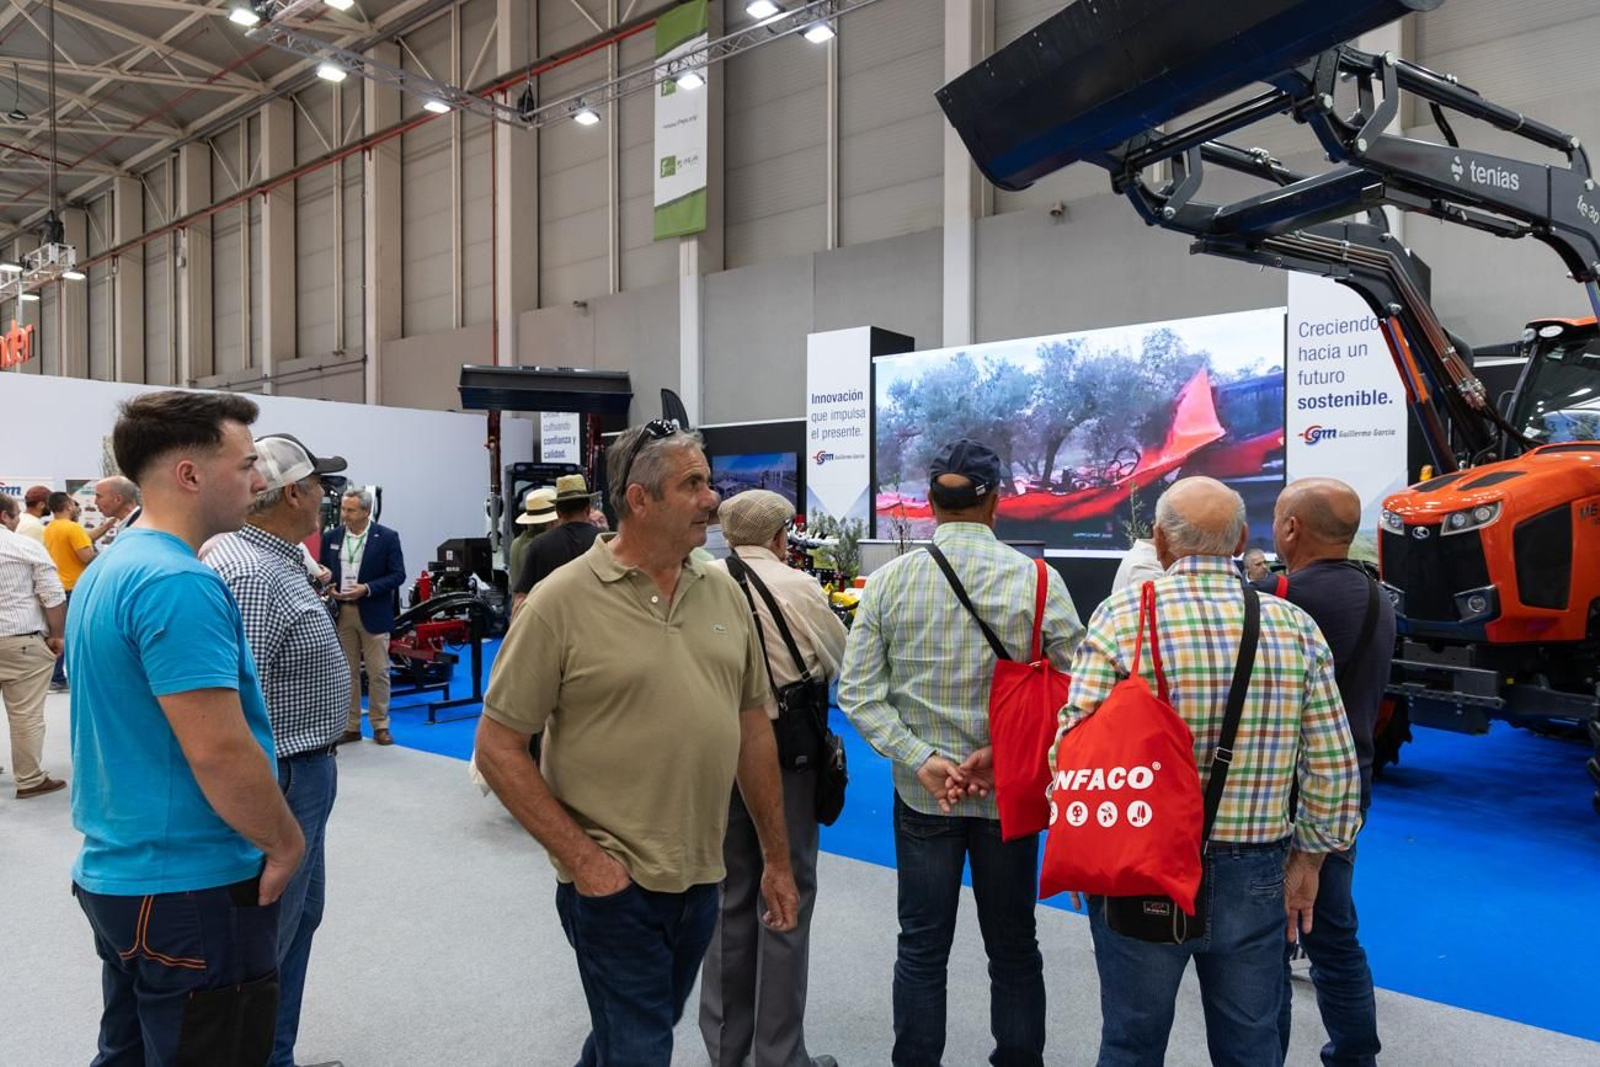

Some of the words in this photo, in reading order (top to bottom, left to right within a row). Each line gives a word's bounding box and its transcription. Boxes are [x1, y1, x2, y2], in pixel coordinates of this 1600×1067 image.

[1298, 316, 1380, 338] Creciendo
[1298, 344, 1341, 362] hacia
[1348, 343, 1368, 358] un
[1297, 370, 1345, 386] futuro
[811, 388, 863, 405] Innovación
[1297, 389, 1393, 410] sostenible.
[811, 411, 828, 423] que
[830, 408, 866, 422] impulsa
[811, 428, 819, 440] el
[821, 426, 864, 440] presente.
[1055, 766, 1154, 791] NFACO
